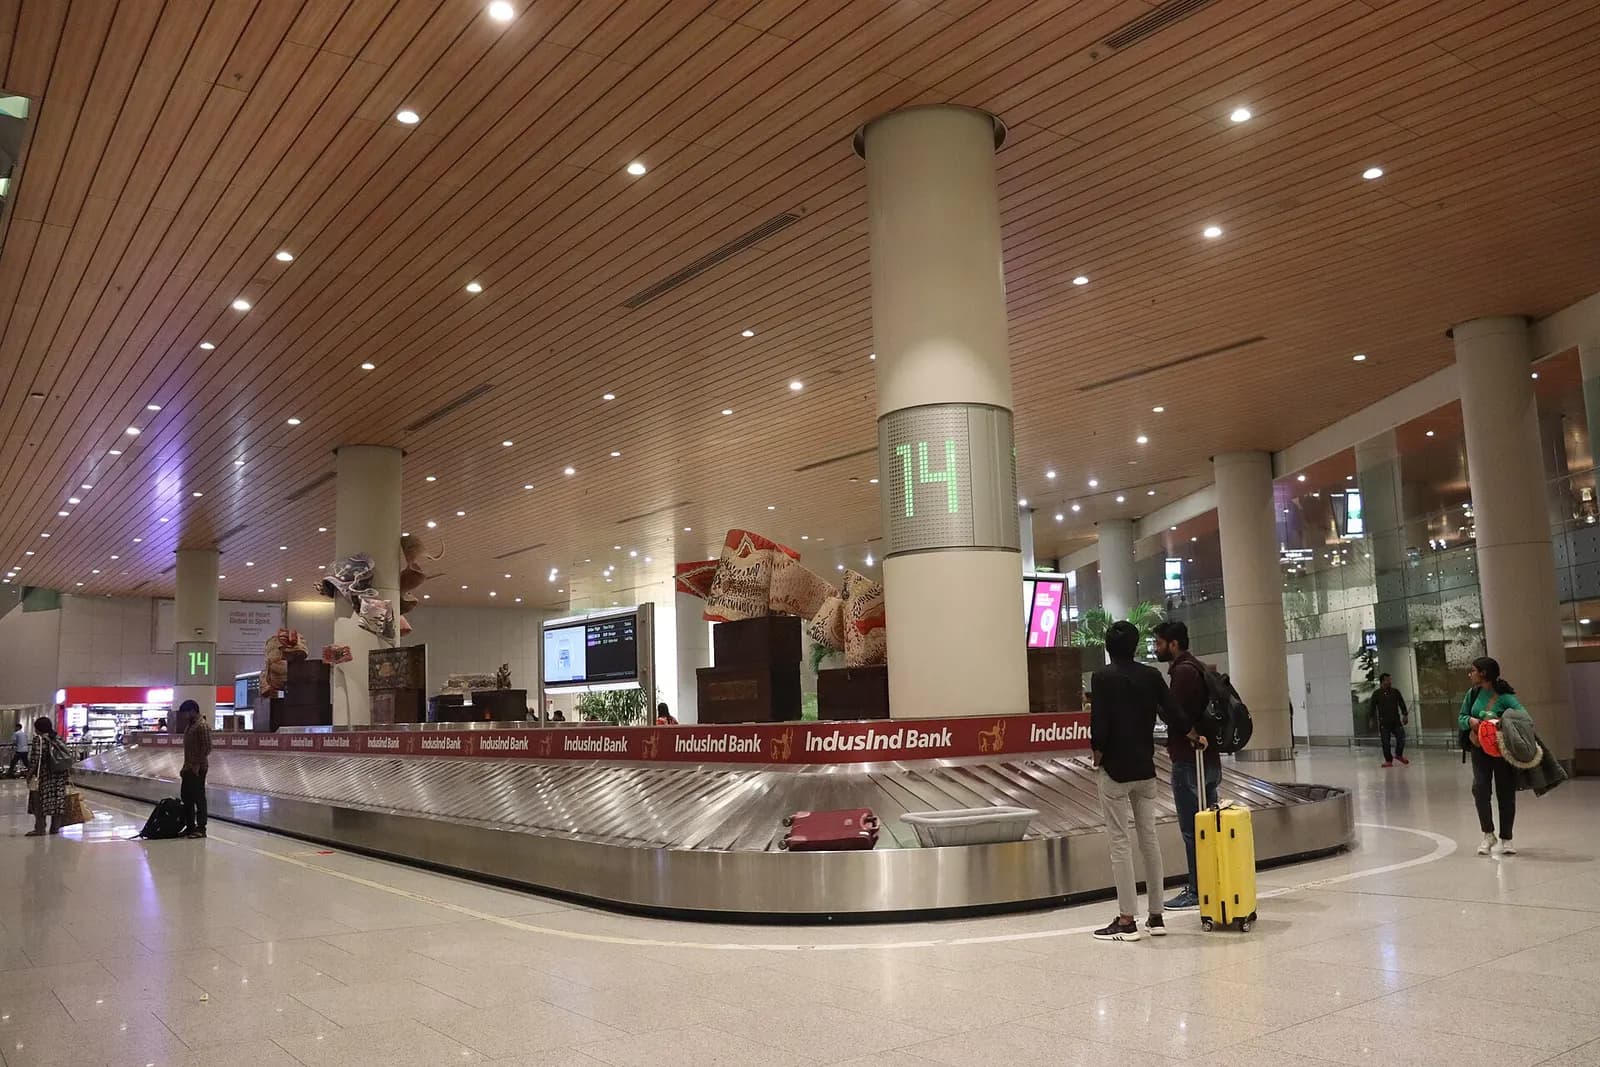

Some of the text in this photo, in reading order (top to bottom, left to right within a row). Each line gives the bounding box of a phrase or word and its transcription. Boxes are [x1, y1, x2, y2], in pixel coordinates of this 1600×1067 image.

[896, 439, 957, 517] 14
[188, 652, 208, 675] 14
[422, 736, 461, 749] IndusInd Bank
[480, 736, 529, 750] IndusInd Bank
[564, 735, 628, 752] IndusInd Bank
[675, 733, 761, 752] IndusInd Bank
[805, 727, 952, 751] IndusInd Bank
